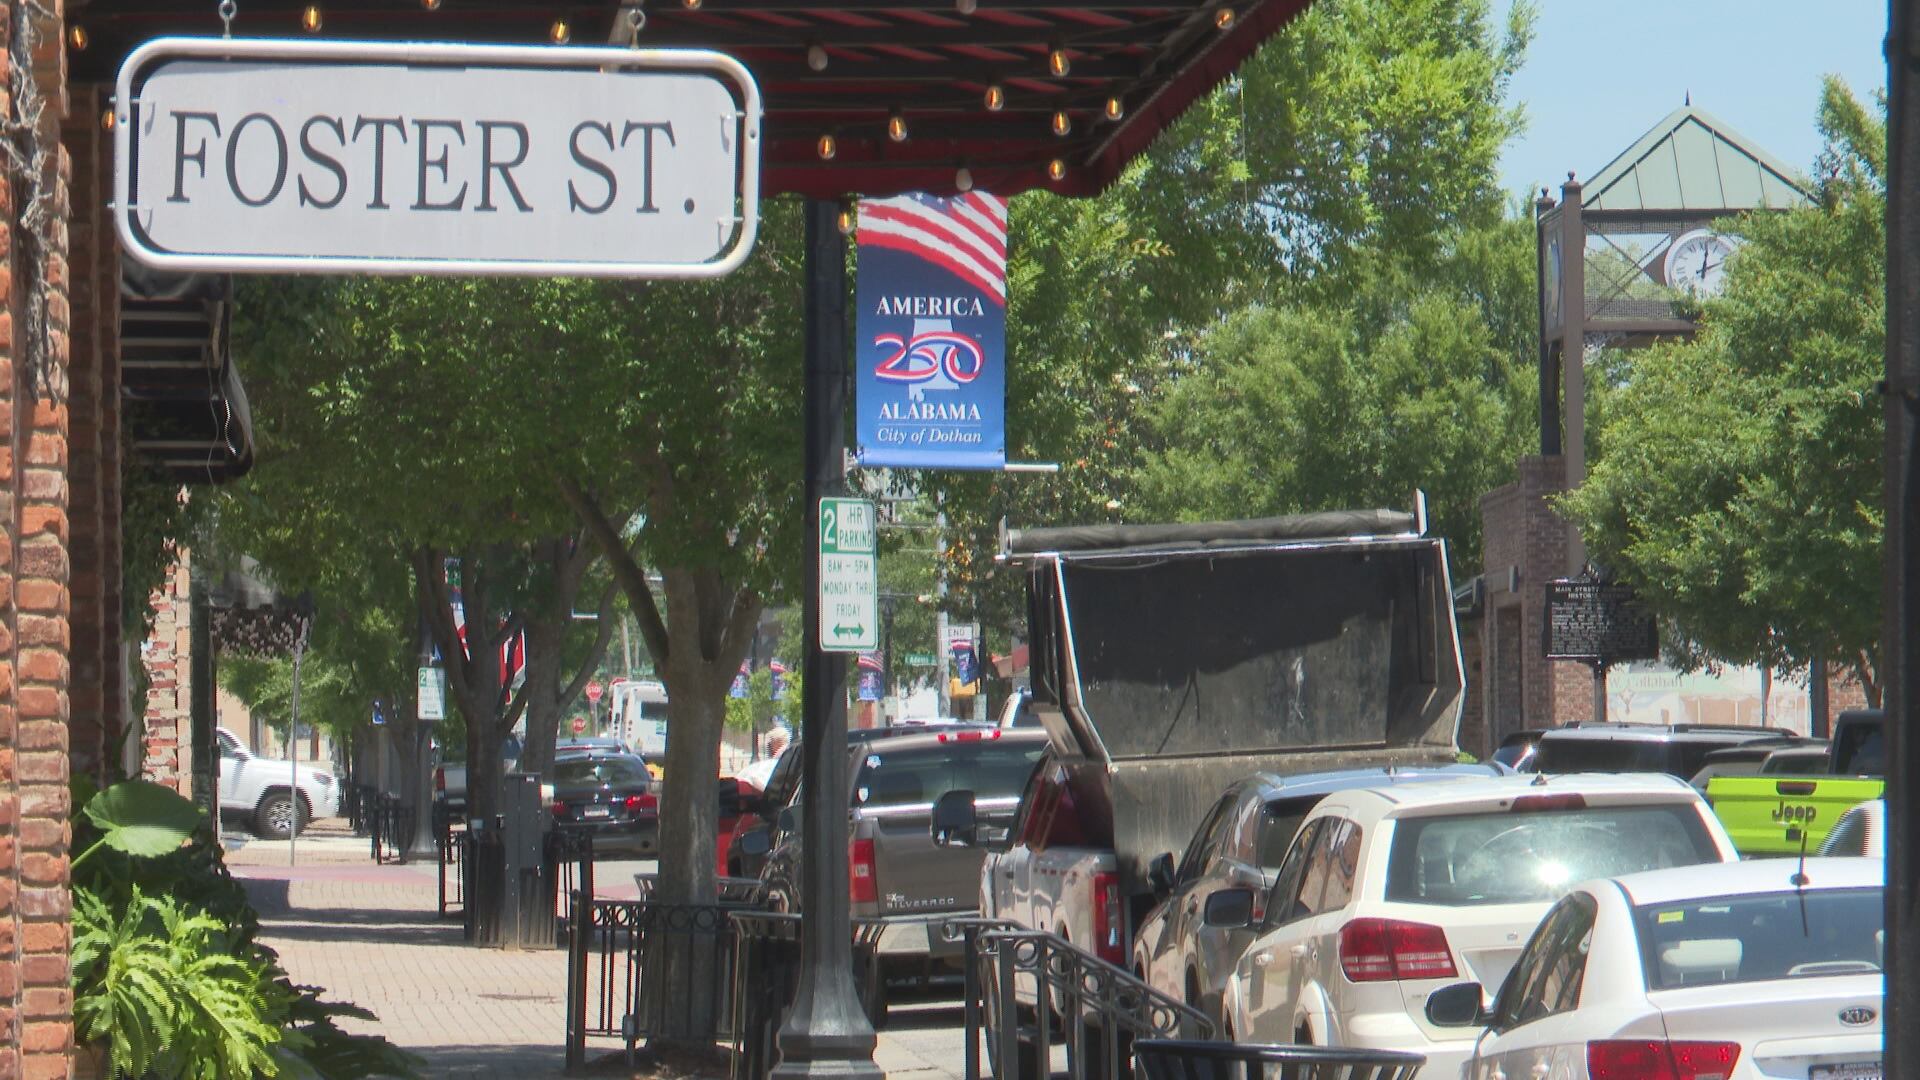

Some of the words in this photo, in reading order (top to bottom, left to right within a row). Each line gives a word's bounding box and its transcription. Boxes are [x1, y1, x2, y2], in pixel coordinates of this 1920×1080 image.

[166, 109, 534, 214] FOSTER
[567, 120, 697, 215] ST.
[876, 296, 984, 316] AMERICA
[875, 332, 983, 384] 250
[878, 402, 982, 421] ALABAMA
[877, 427, 907, 444] City
[911, 427, 925, 444] of
[928, 428, 983, 443] Dothan
[849, 507, 863, 524] HR
[823, 508, 836, 545] 2
[839, 529, 873, 548] PARKING
[827, 559, 843, 572] 8AM
[855, 560, 869, 572] 5PM
[823, 582, 852, 595] MONDAY
[855, 582, 872, 595] THRU
[836, 604, 861, 617] FRIDAY
[948, 628, 965, 638] END
[420, 671, 425, 684] 2
[1771, 800, 1817, 825] Jeep
[886, 897, 954, 909] SILVERADO
[1845, 1008, 1870, 1022] KIA
